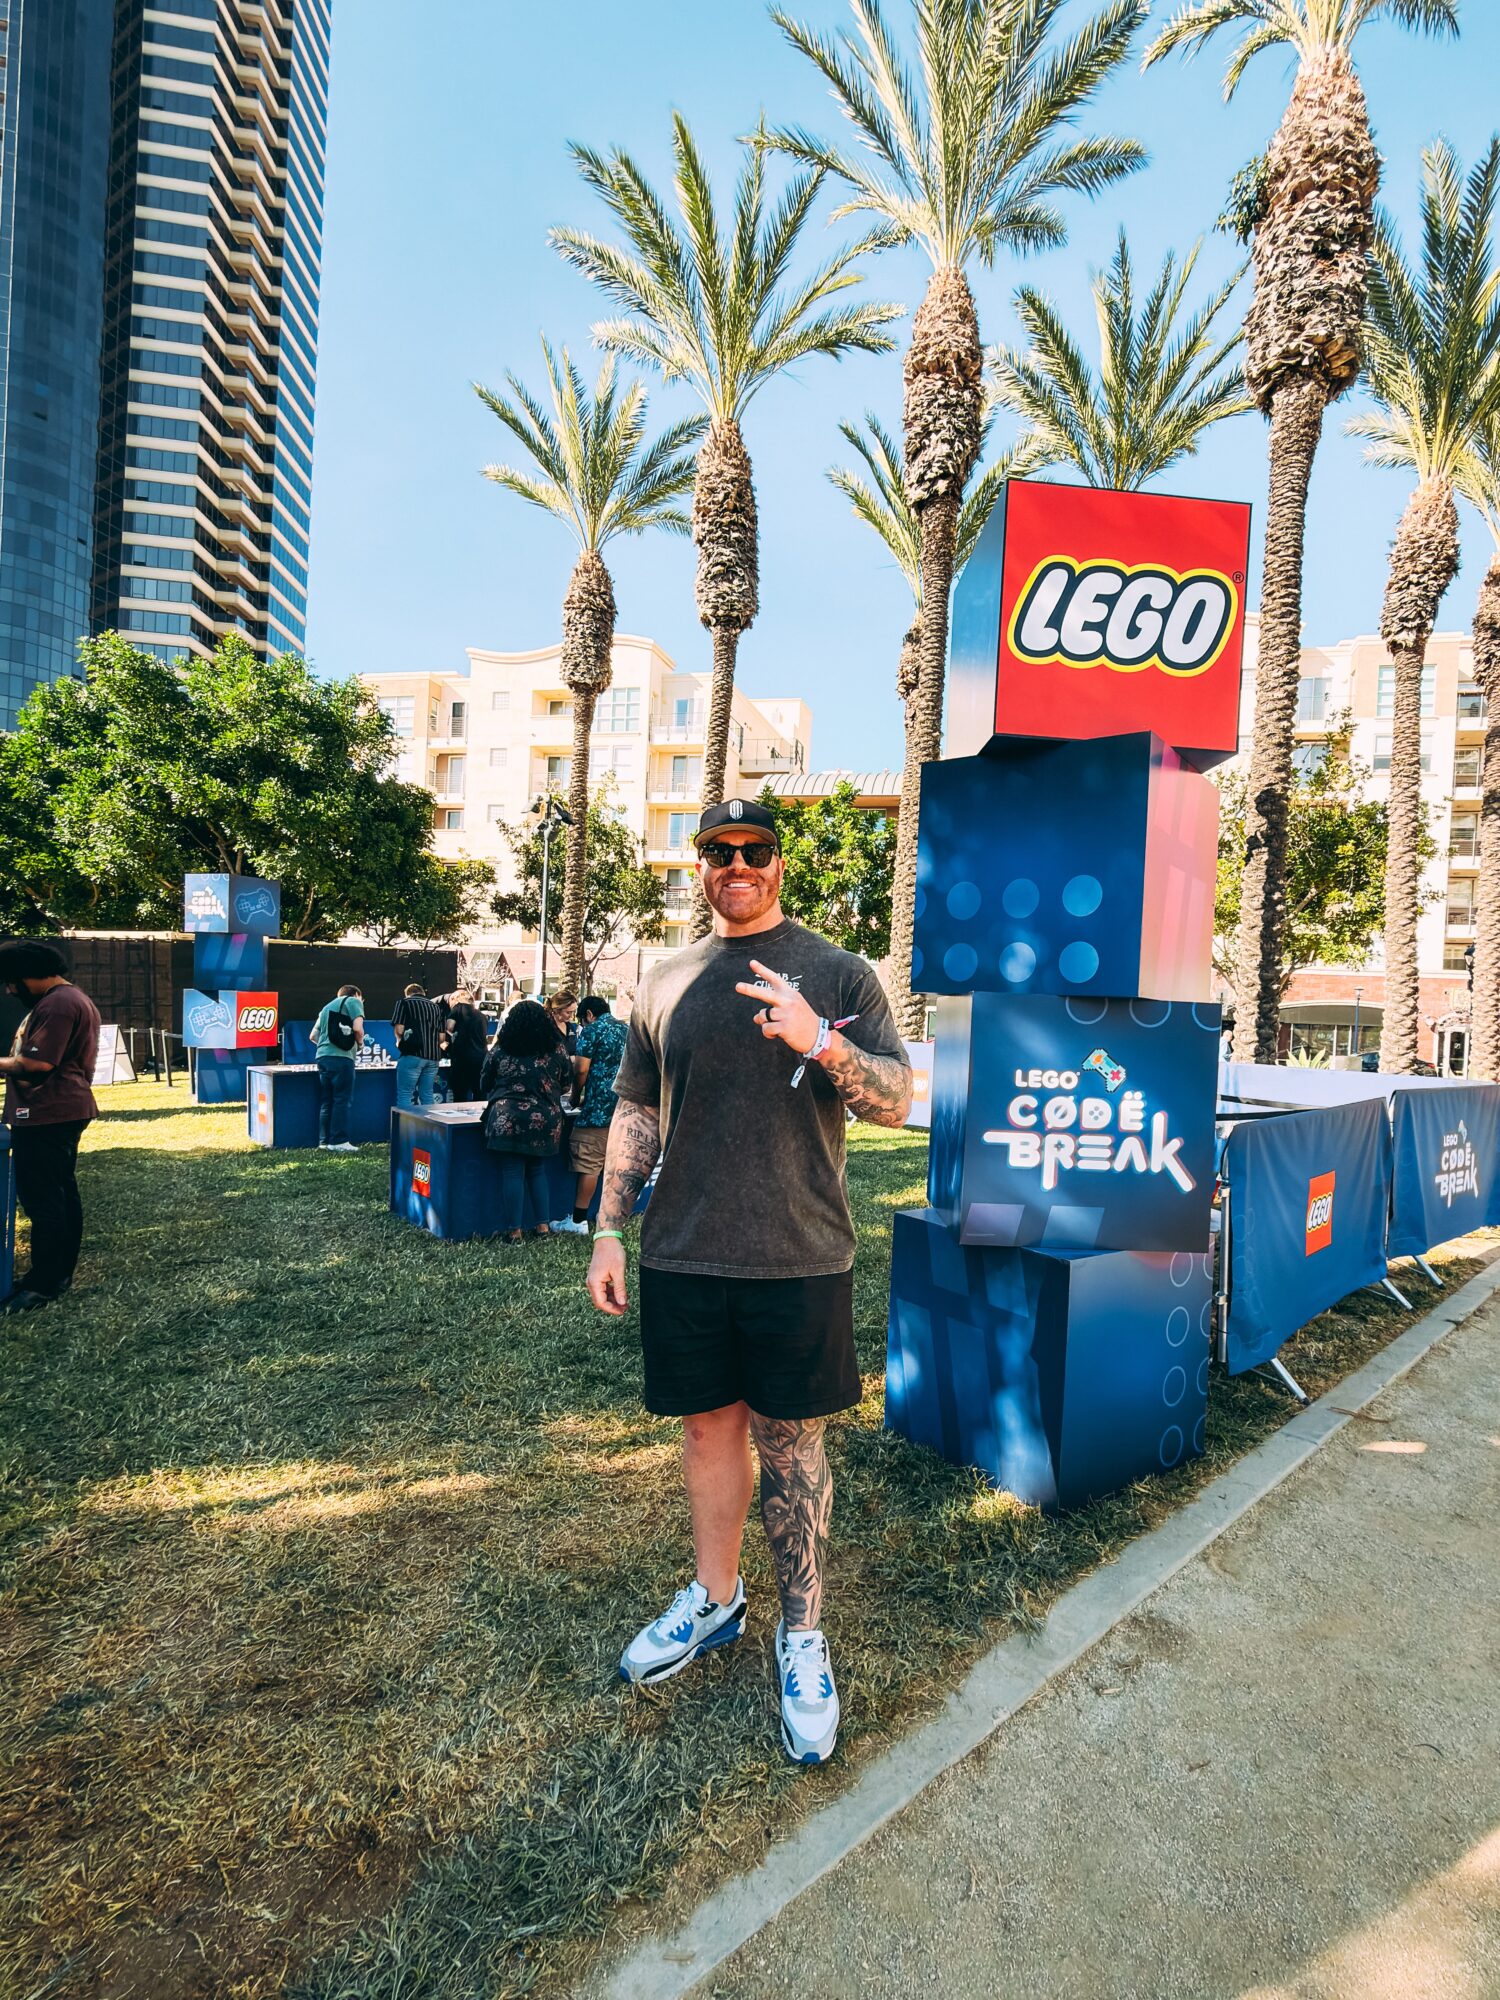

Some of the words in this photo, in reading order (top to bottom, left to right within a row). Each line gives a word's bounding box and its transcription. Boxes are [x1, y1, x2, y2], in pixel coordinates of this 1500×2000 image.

[1018, 566, 1228, 666] LEGO
[239, 1008, 276, 1030] LEGO
[1015, 1068, 1079, 1090] LEGO
[627, 1127, 643, 1140] RIP
[1443, 1133, 1459, 1147] LEGO
[414, 1161, 430, 1182] LEGO
[1307, 1194, 1332, 1231] LEGO
